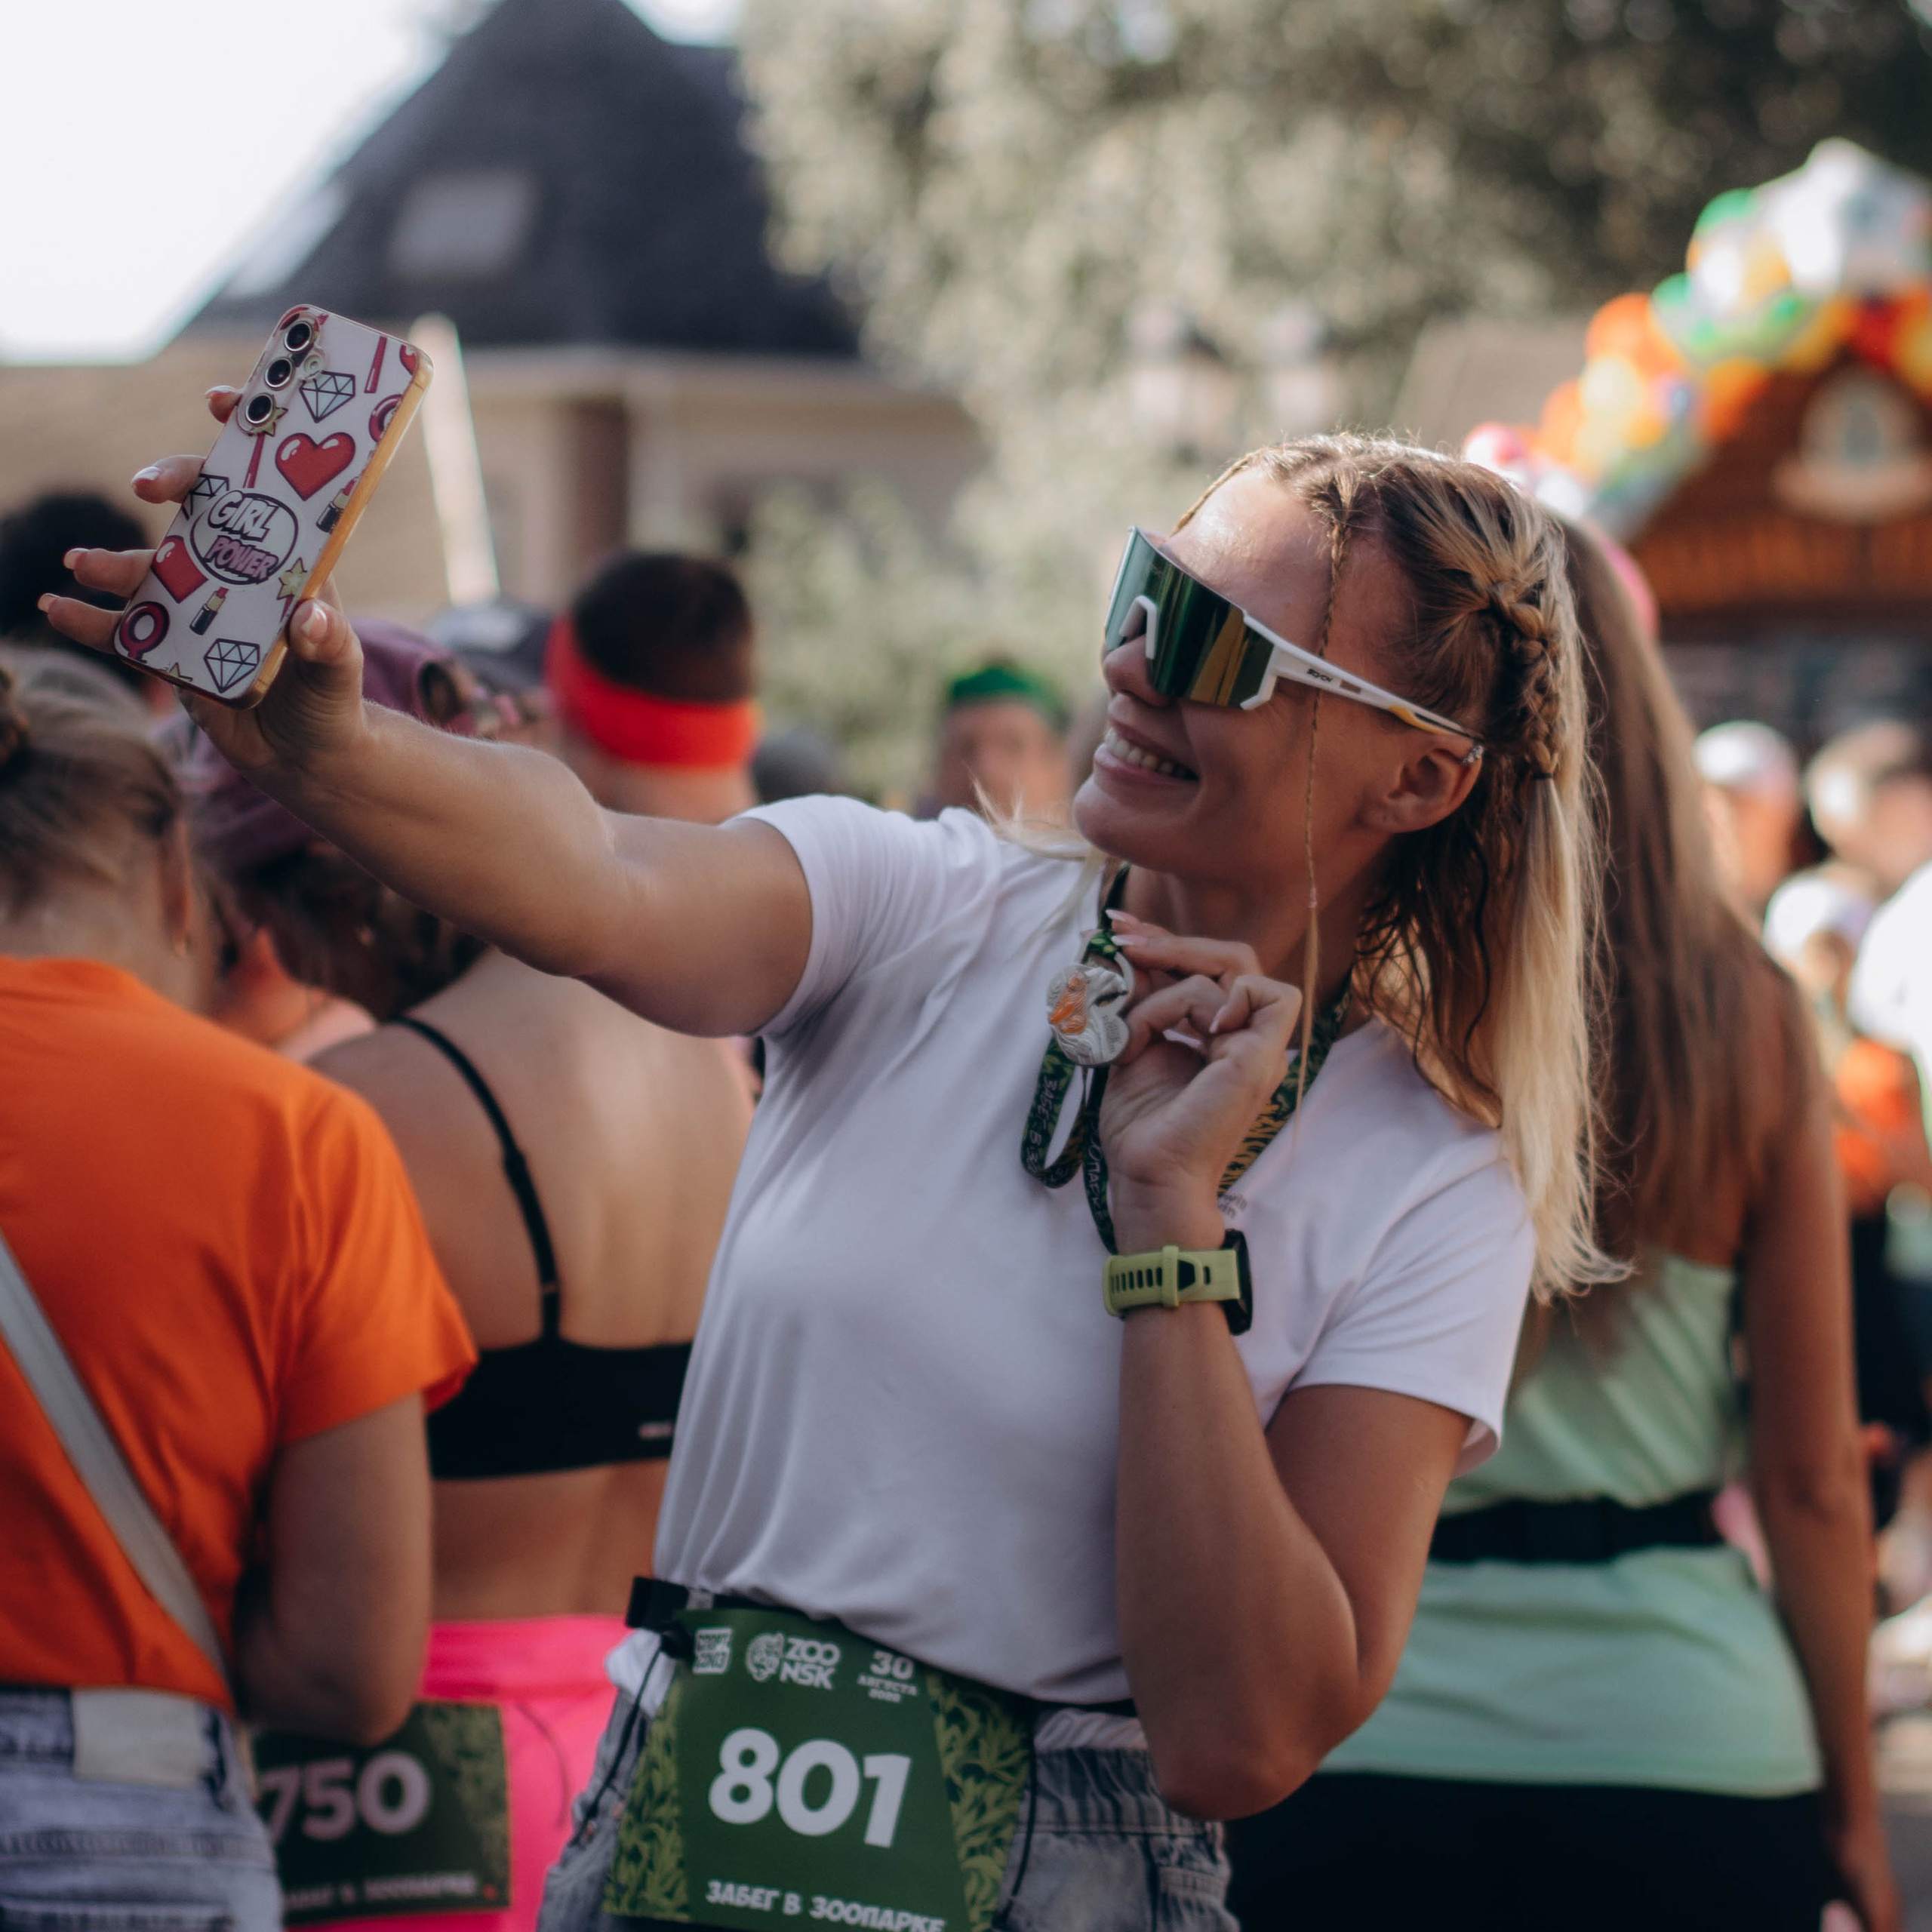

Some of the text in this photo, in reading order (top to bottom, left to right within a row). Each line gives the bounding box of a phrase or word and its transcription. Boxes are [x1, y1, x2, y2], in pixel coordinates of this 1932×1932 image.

[208, 489, 280, 543] GIRL
[205, 534, 279, 582] POWER
[787, 1638, 840, 1666] ZOO
[870, 1651, 914, 1680] 30
[780, 1663, 835, 1690] NSK
[258, 1750, 432, 1846] 750
[708, 1726, 913, 1848] 801
[706, 1881, 780, 1912] ЗАБЕГ
[782, 1892, 801, 1915] В
